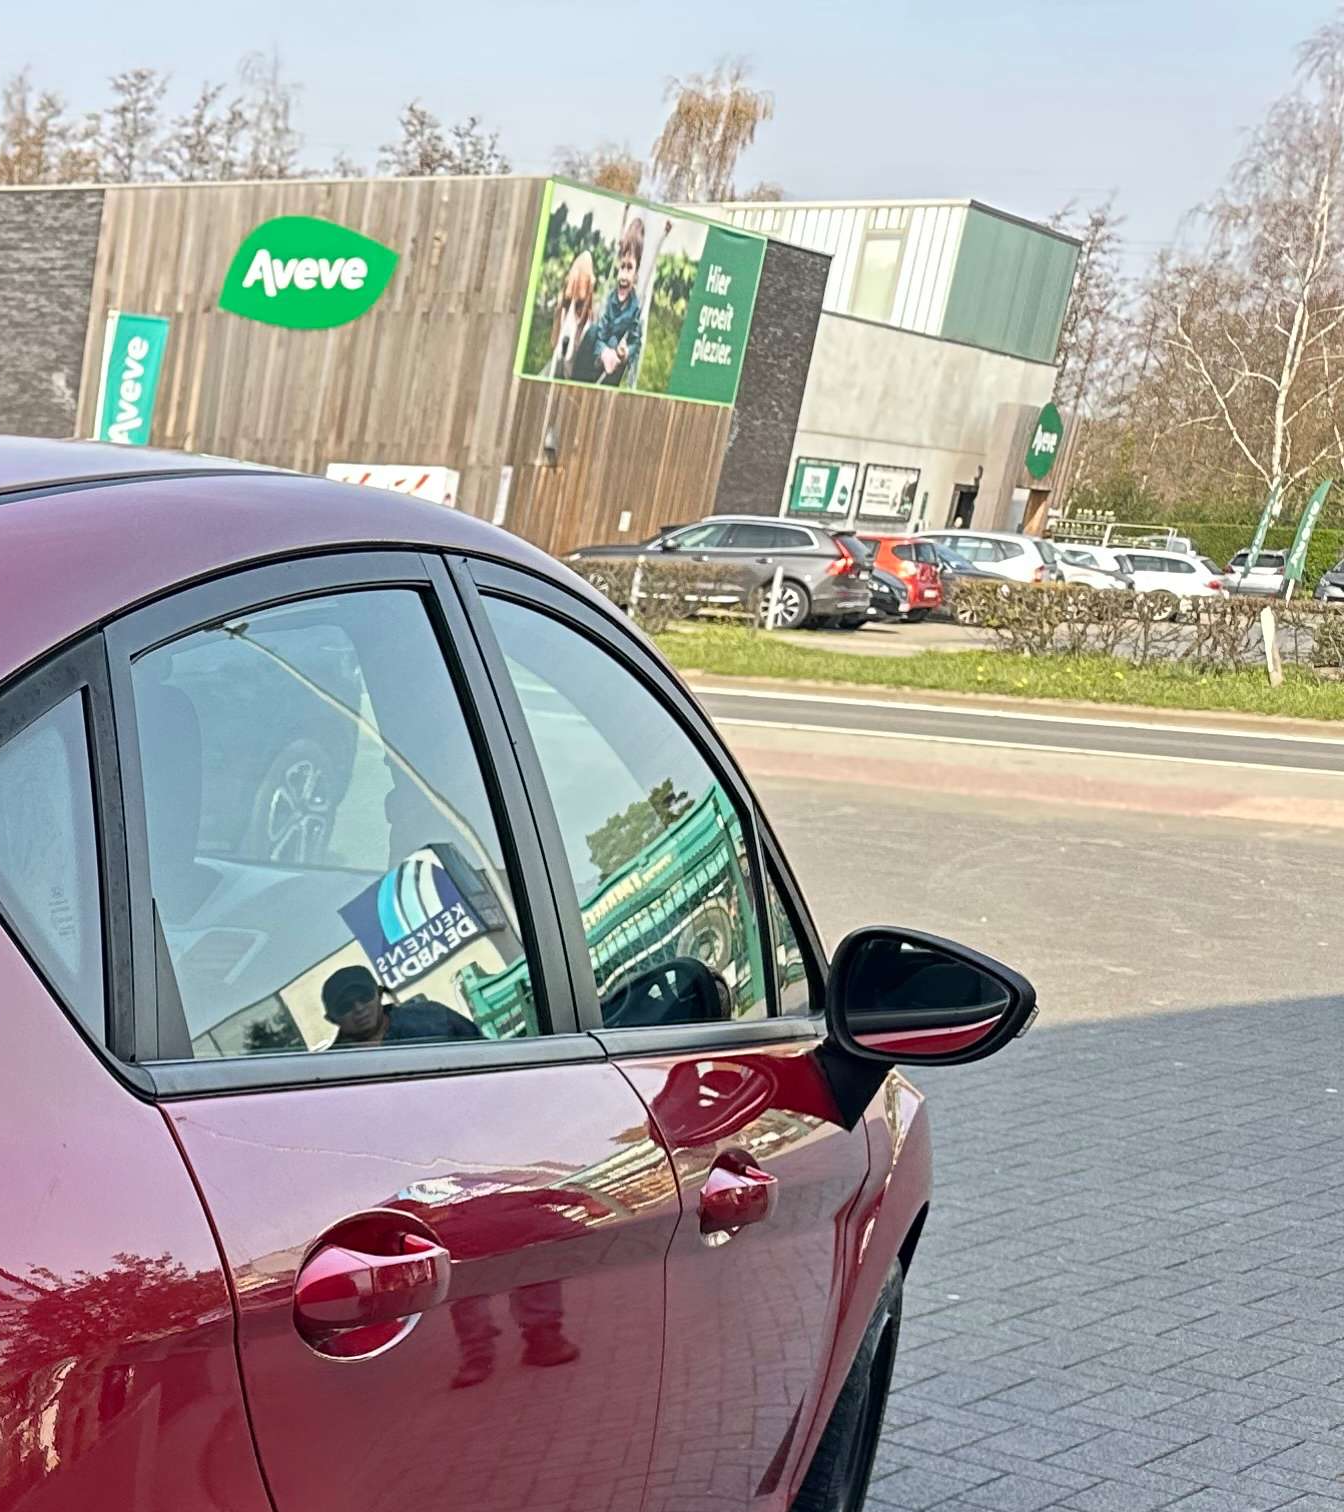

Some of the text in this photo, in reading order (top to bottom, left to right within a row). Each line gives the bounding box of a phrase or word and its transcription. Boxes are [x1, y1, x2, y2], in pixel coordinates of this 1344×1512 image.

[242, 248, 368, 297] Aveve
[705, 263, 732, 296] Hier
[697, 303, 734, 334] groeit
[690, 333, 732, 367] plezier.
[108, 336, 149, 445] Aveve
